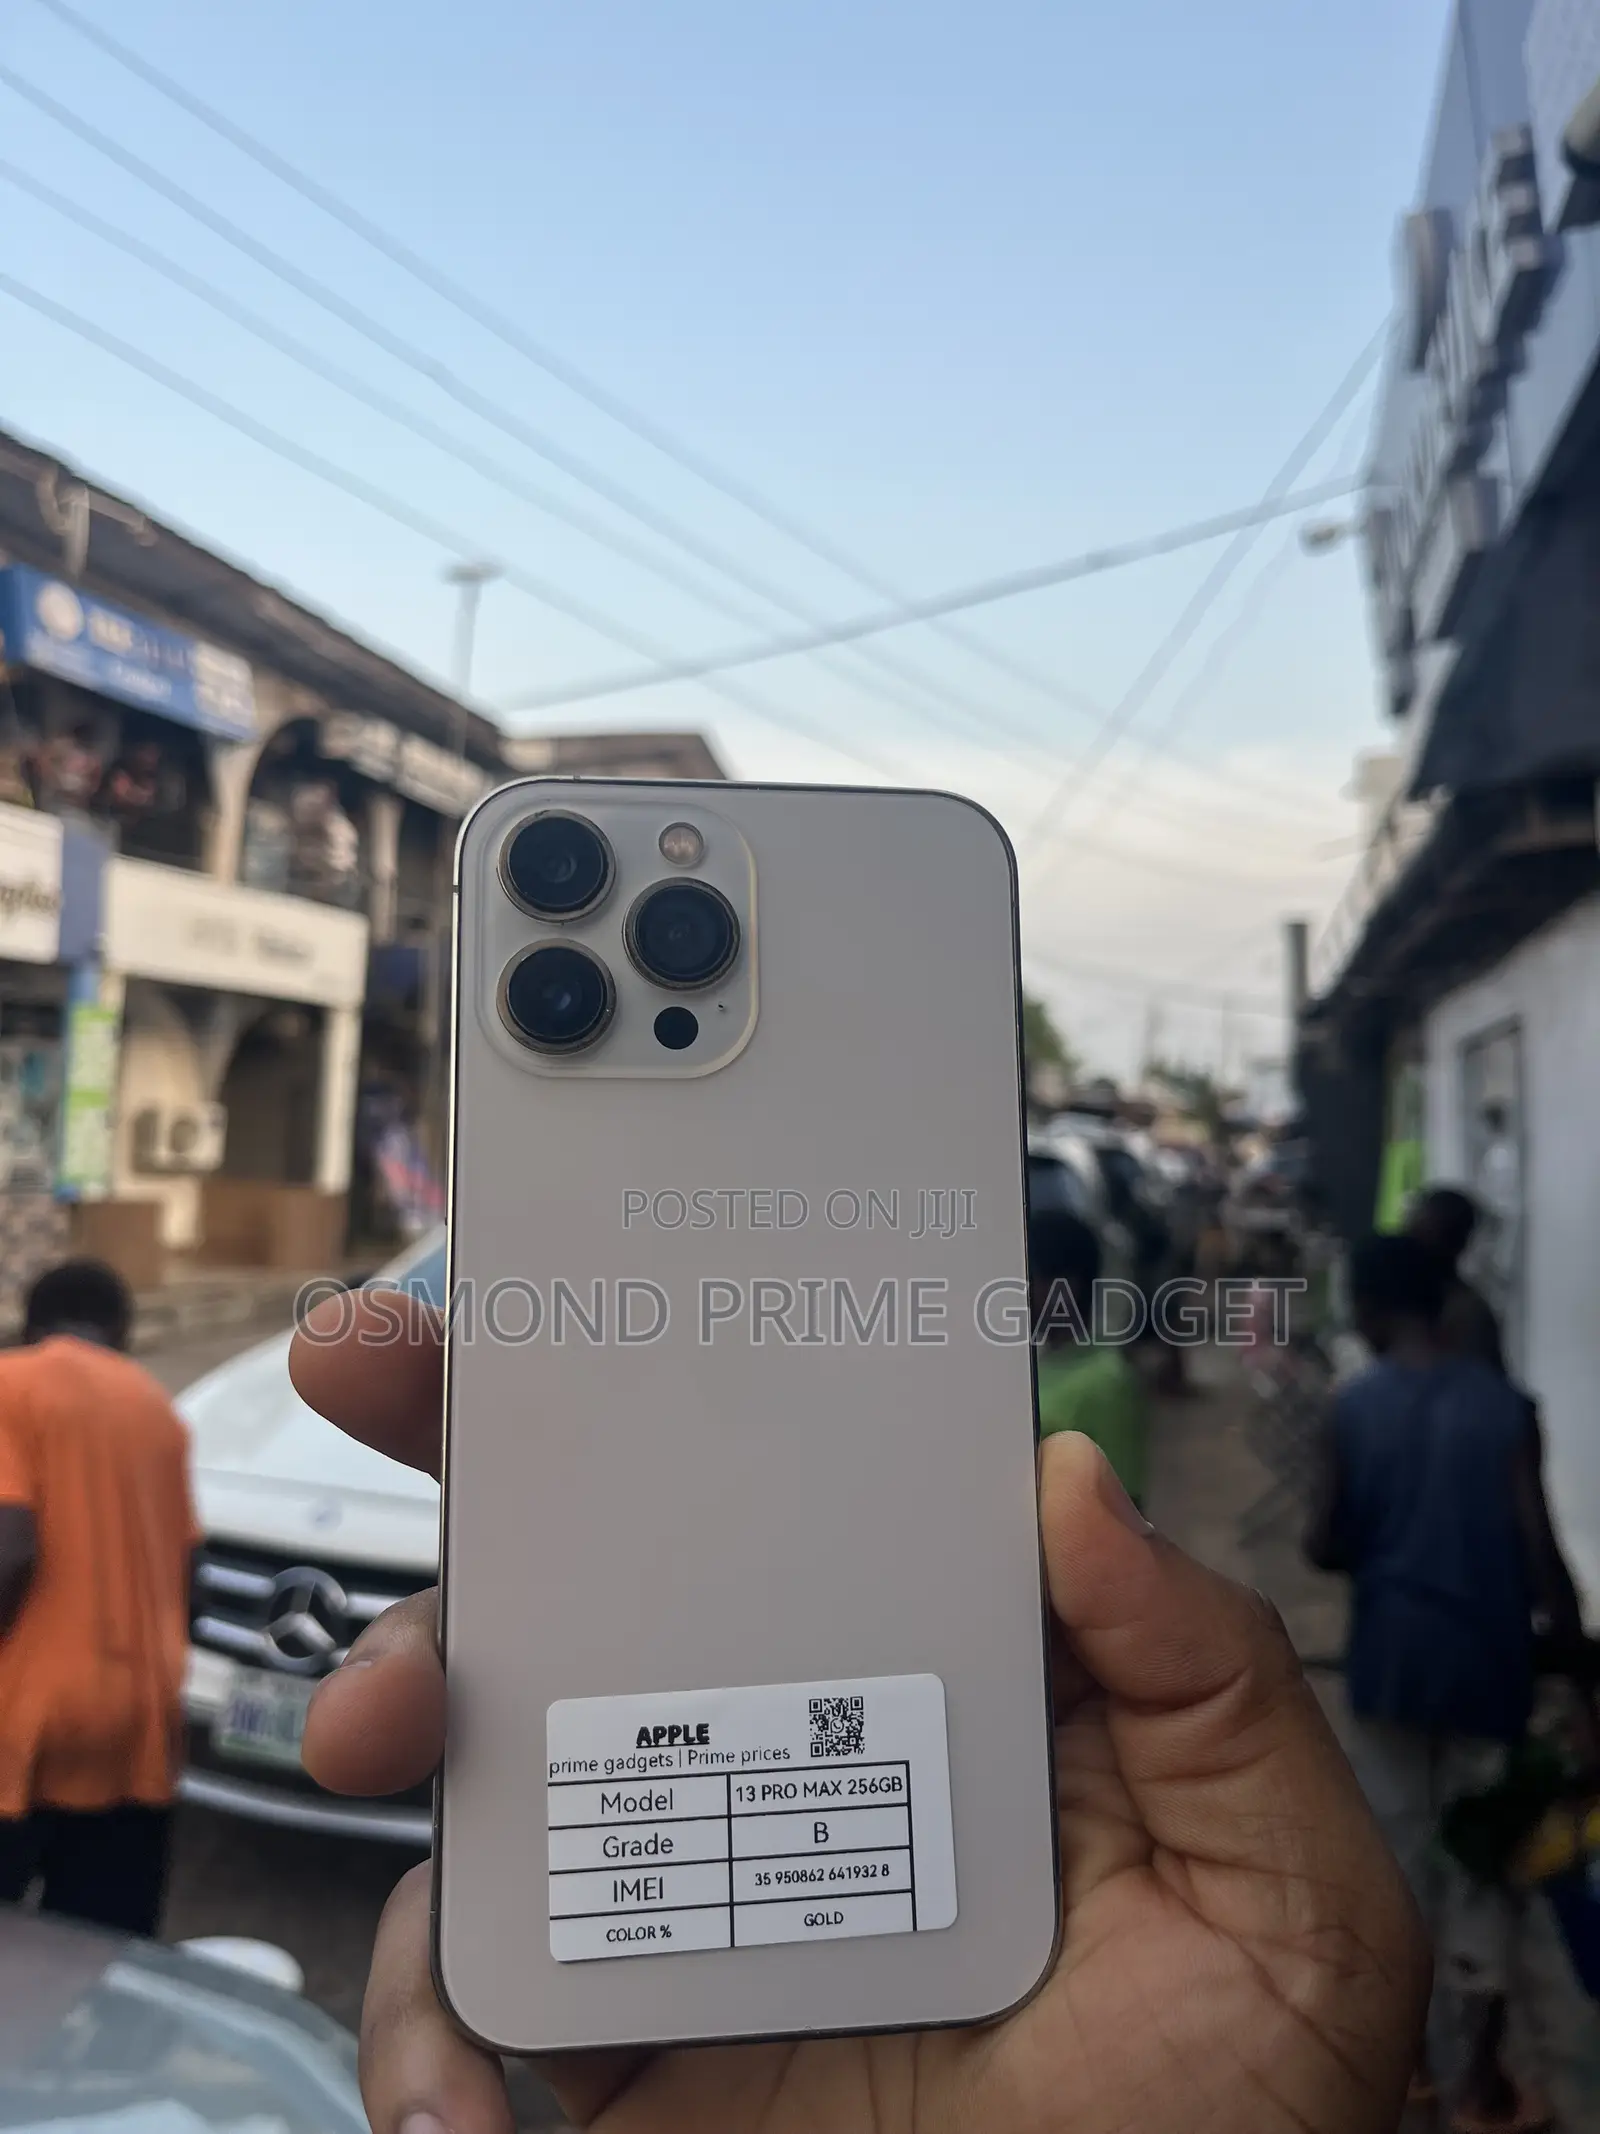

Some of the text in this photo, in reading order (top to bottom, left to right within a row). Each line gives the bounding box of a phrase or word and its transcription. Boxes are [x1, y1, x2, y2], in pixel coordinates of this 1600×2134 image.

[635, 1723, 710, 1749] APPLE
[549, 1757, 599, 1779] prime
[604, 1752, 674, 1775] gadgets
[687, 1748, 736, 1766] Prime
[741, 1746, 791, 1767] prices
[601, 1788, 674, 1815] Model
[736, 1775, 904, 1803] 13 PRO MAX 256GB
[602, 1832, 674, 1859] Grade
[813, 1821, 830, 1844] B
[754, 1863, 890, 1887] 35 950862 641932 8
[613, 1876, 665, 1903] IMEI
[803, 1911, 844, 1927] GOLD
[605, 1924, 673, 1943] COLOR %
